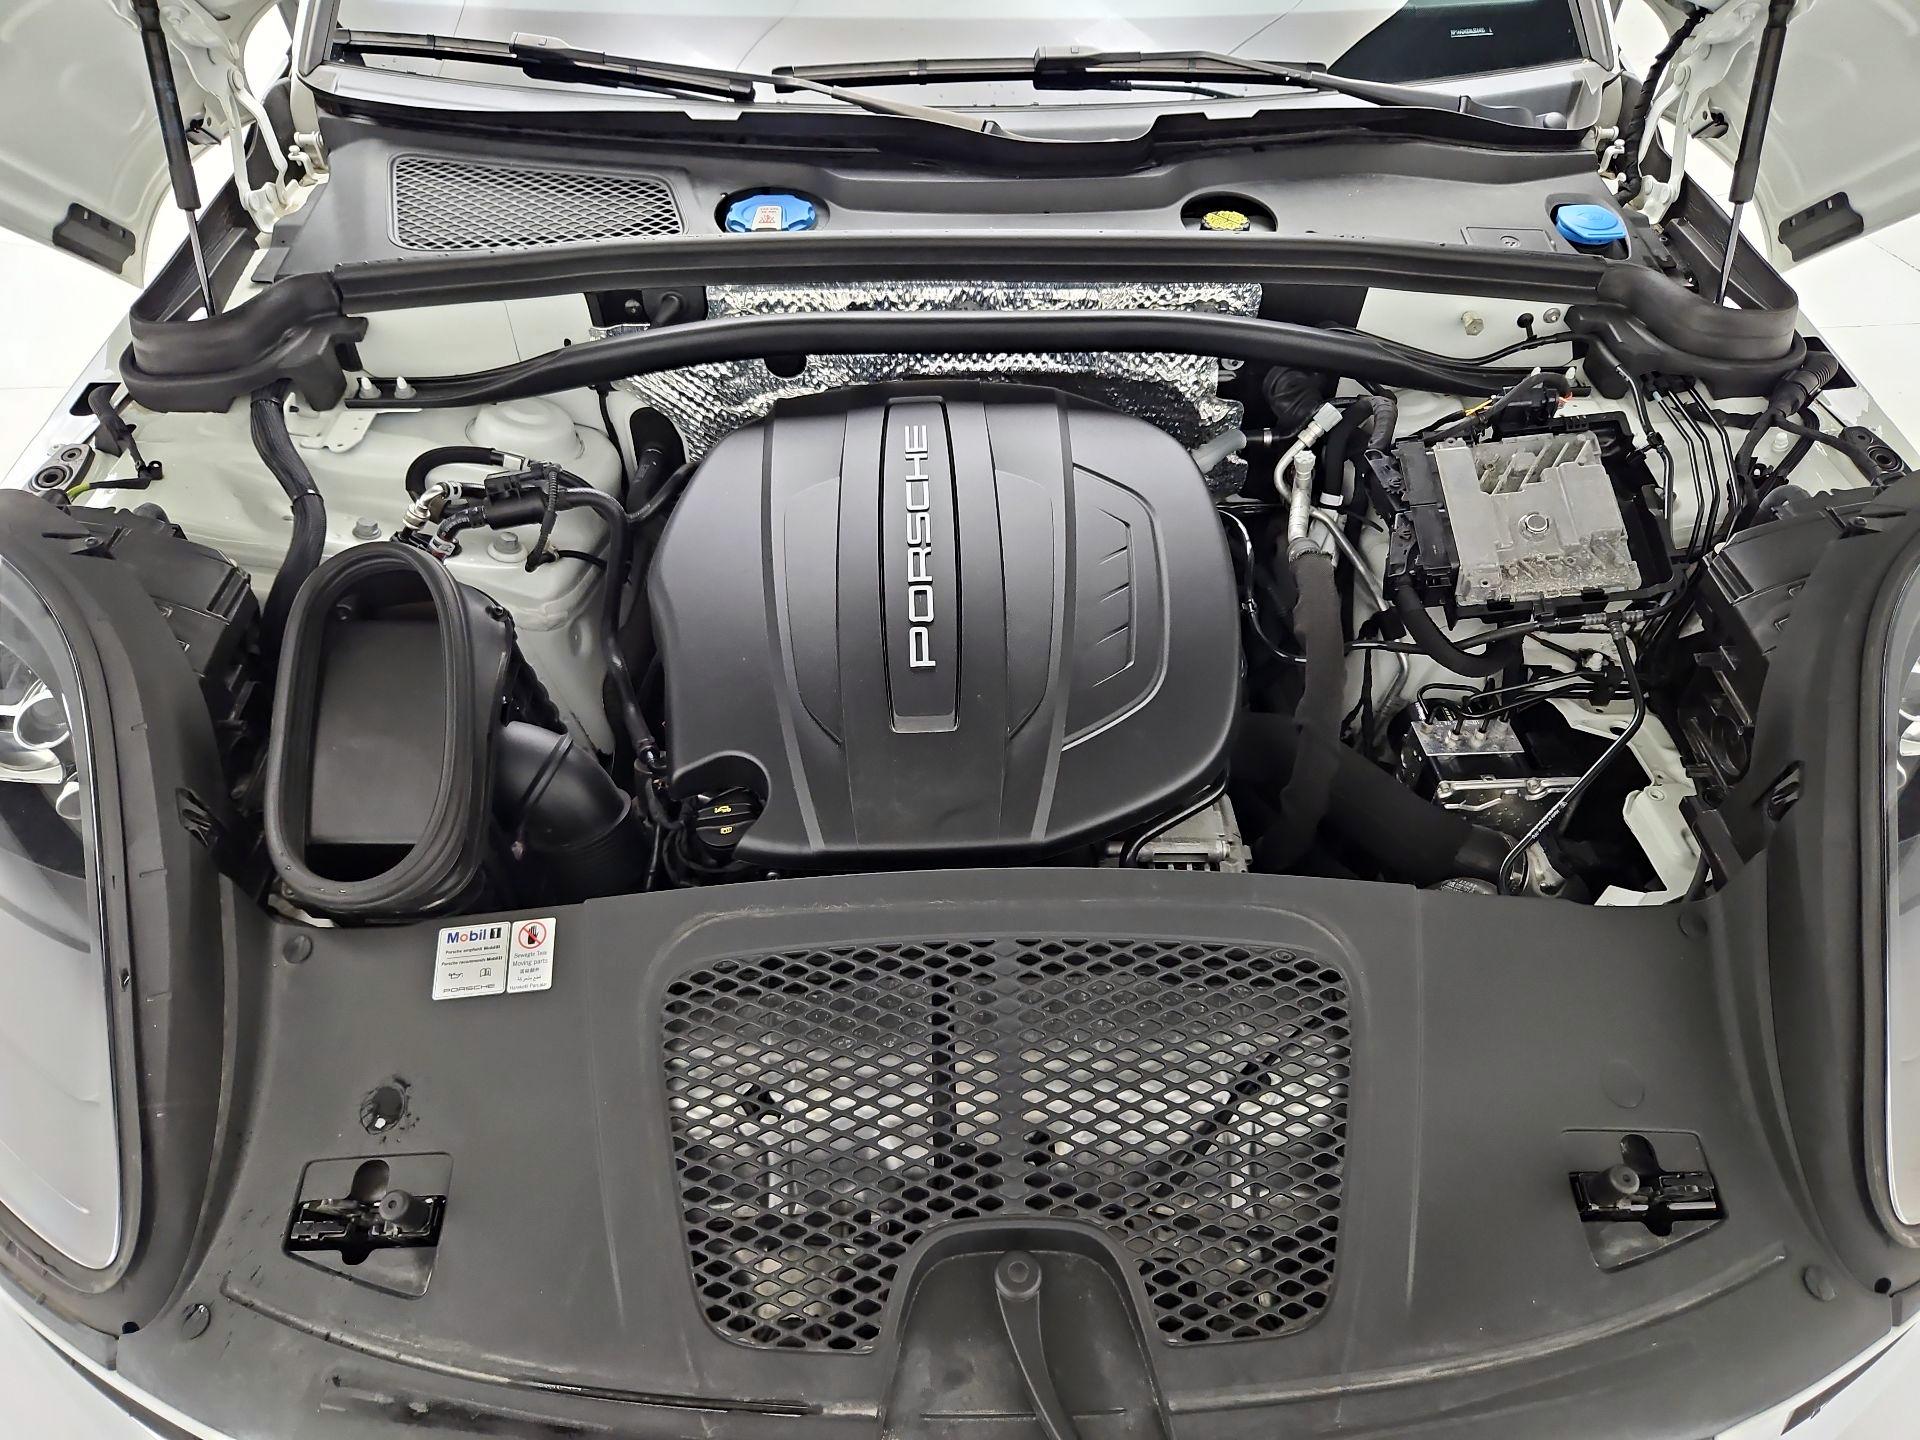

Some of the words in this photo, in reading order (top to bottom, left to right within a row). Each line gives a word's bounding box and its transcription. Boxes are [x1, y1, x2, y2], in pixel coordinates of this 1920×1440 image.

[904, 424, 937, 669] PORSCHE
[446, 928, 487, 944] Mobil
[512, 959, 533, 967] Moving
[533, 958, 549, 966] parts
[442, 983, 496, 994] PORSCHE
